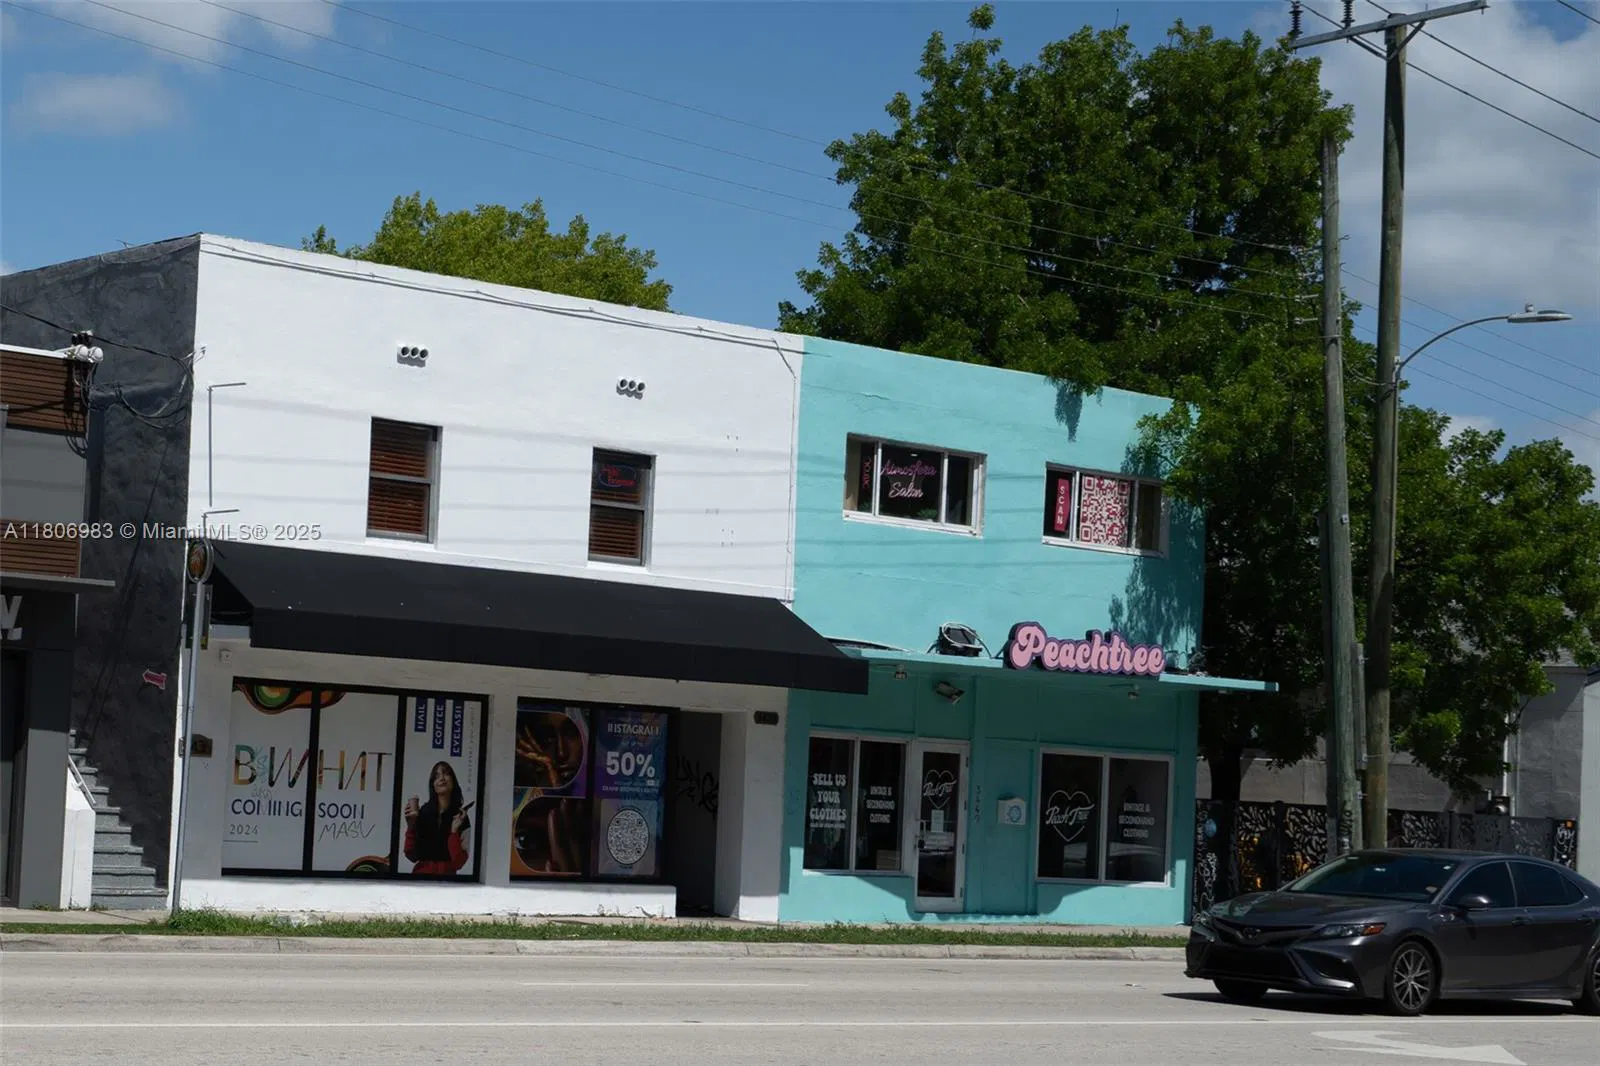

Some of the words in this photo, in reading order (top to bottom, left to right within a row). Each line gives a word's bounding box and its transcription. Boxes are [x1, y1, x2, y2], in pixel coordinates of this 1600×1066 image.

[888, 481, 924, 499] Salon
[1055, 486, 1066, 525] SCAN
[1009, 623, 1166, 675] Peachtree
[607, 723, 660, 736] INSTAGRAM
[606, 751, 656, 778] 50%
[812, 773, 833, 785] SELL
[835, 774, 847, 786] US
[817, 790, 841, 803] YOUR
[231, 797, 303, 817] COMING
[318, 802, 365, 820] SOON
[810, 807, 847, 822] CLOTHES
[229, 823, 259, 836] 2024
